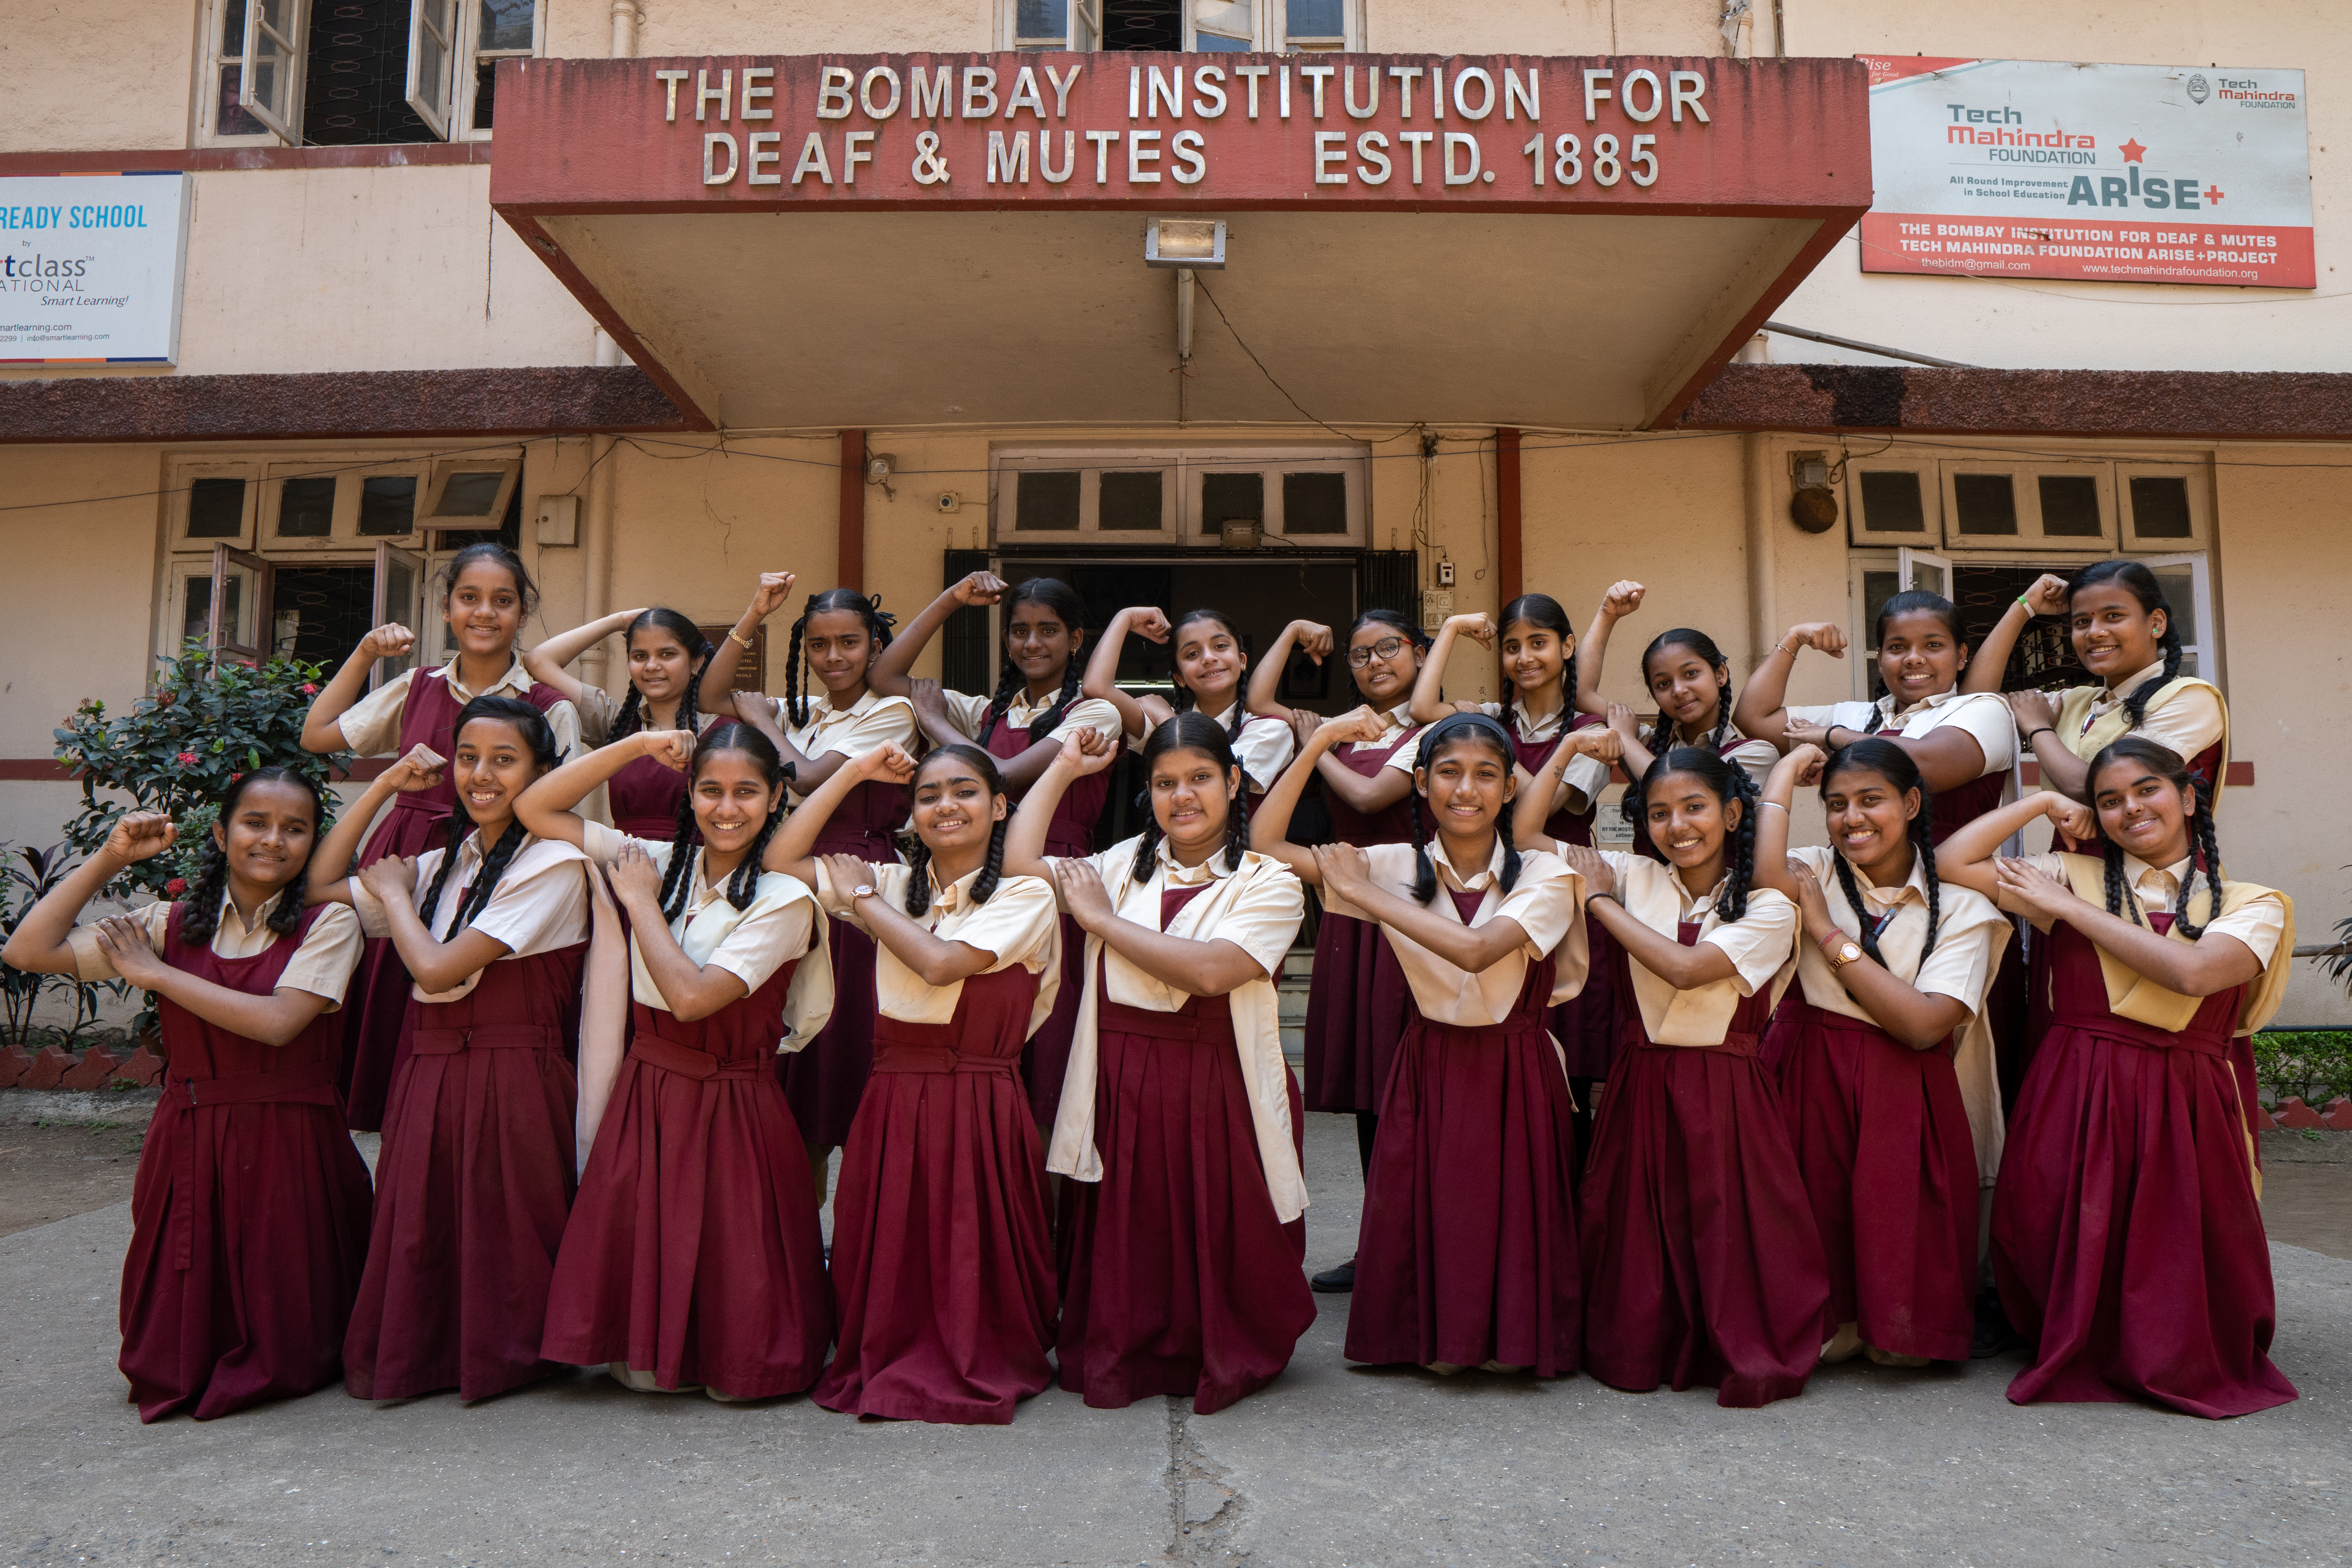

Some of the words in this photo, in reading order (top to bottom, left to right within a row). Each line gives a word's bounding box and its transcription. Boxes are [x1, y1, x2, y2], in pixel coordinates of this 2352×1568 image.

[2219, 79, 2257, 88] Tech
[656, 67, 774, 121] THE
[817, 65, 1082, 120] BOMBAY
[1128, 65, 1540, 121] INSTITUTION
[1584, 69, 1710, 123] FOR
[2219, 89, 2295, 101] Mahindra
[1947, 104, 2022, 124] Tech
[1947, 126, 2095, 148] Mahindra
[704, 131, 875, 185] DEAF
[912, 130, 950, 185] &
[987, 130, 1206, 184] MUTES
[1315, 131, 1495, 185] ESTD.
[1525, 133, 1658, 186] 1885
[1989, 149, 2096, 164] FOUNDATION
[2001, 178, 2068, 187] Improvement
[1976, 189, 2010, 197] School
[2013, 190, 2065, 199] Education
[0, 206, 62, 229] READY
[69, 205, 148, 229] SCHOOL
[1899, 223, 1930, 235] THE
[1937, 224, 2005, 237] BOMBAY
[2012, 227, 2113, 241] INSTITUTION
[2120, 231, 2150, 243] FOR
[2157, 232, 2198, 244] DEAF
[2204, 234, 2215, 245] &
[2221, 234, 2277, 247] MUTES
[1900, 239, 1942, 252] TECH
[1947, 241, 2035, 256] MAHINDRA
[2039, 245, 2143, 259] FOUNDATION
[0, 253, 86, 277] tclass
[1921, 257, 2031, 270] thebidm@gmail.com
[2082, 265, 2258, 280] www.techmahindrafoundation.org
[41, 296, 74, 305] Smart
[76, 296, 129, 307] Learning!
